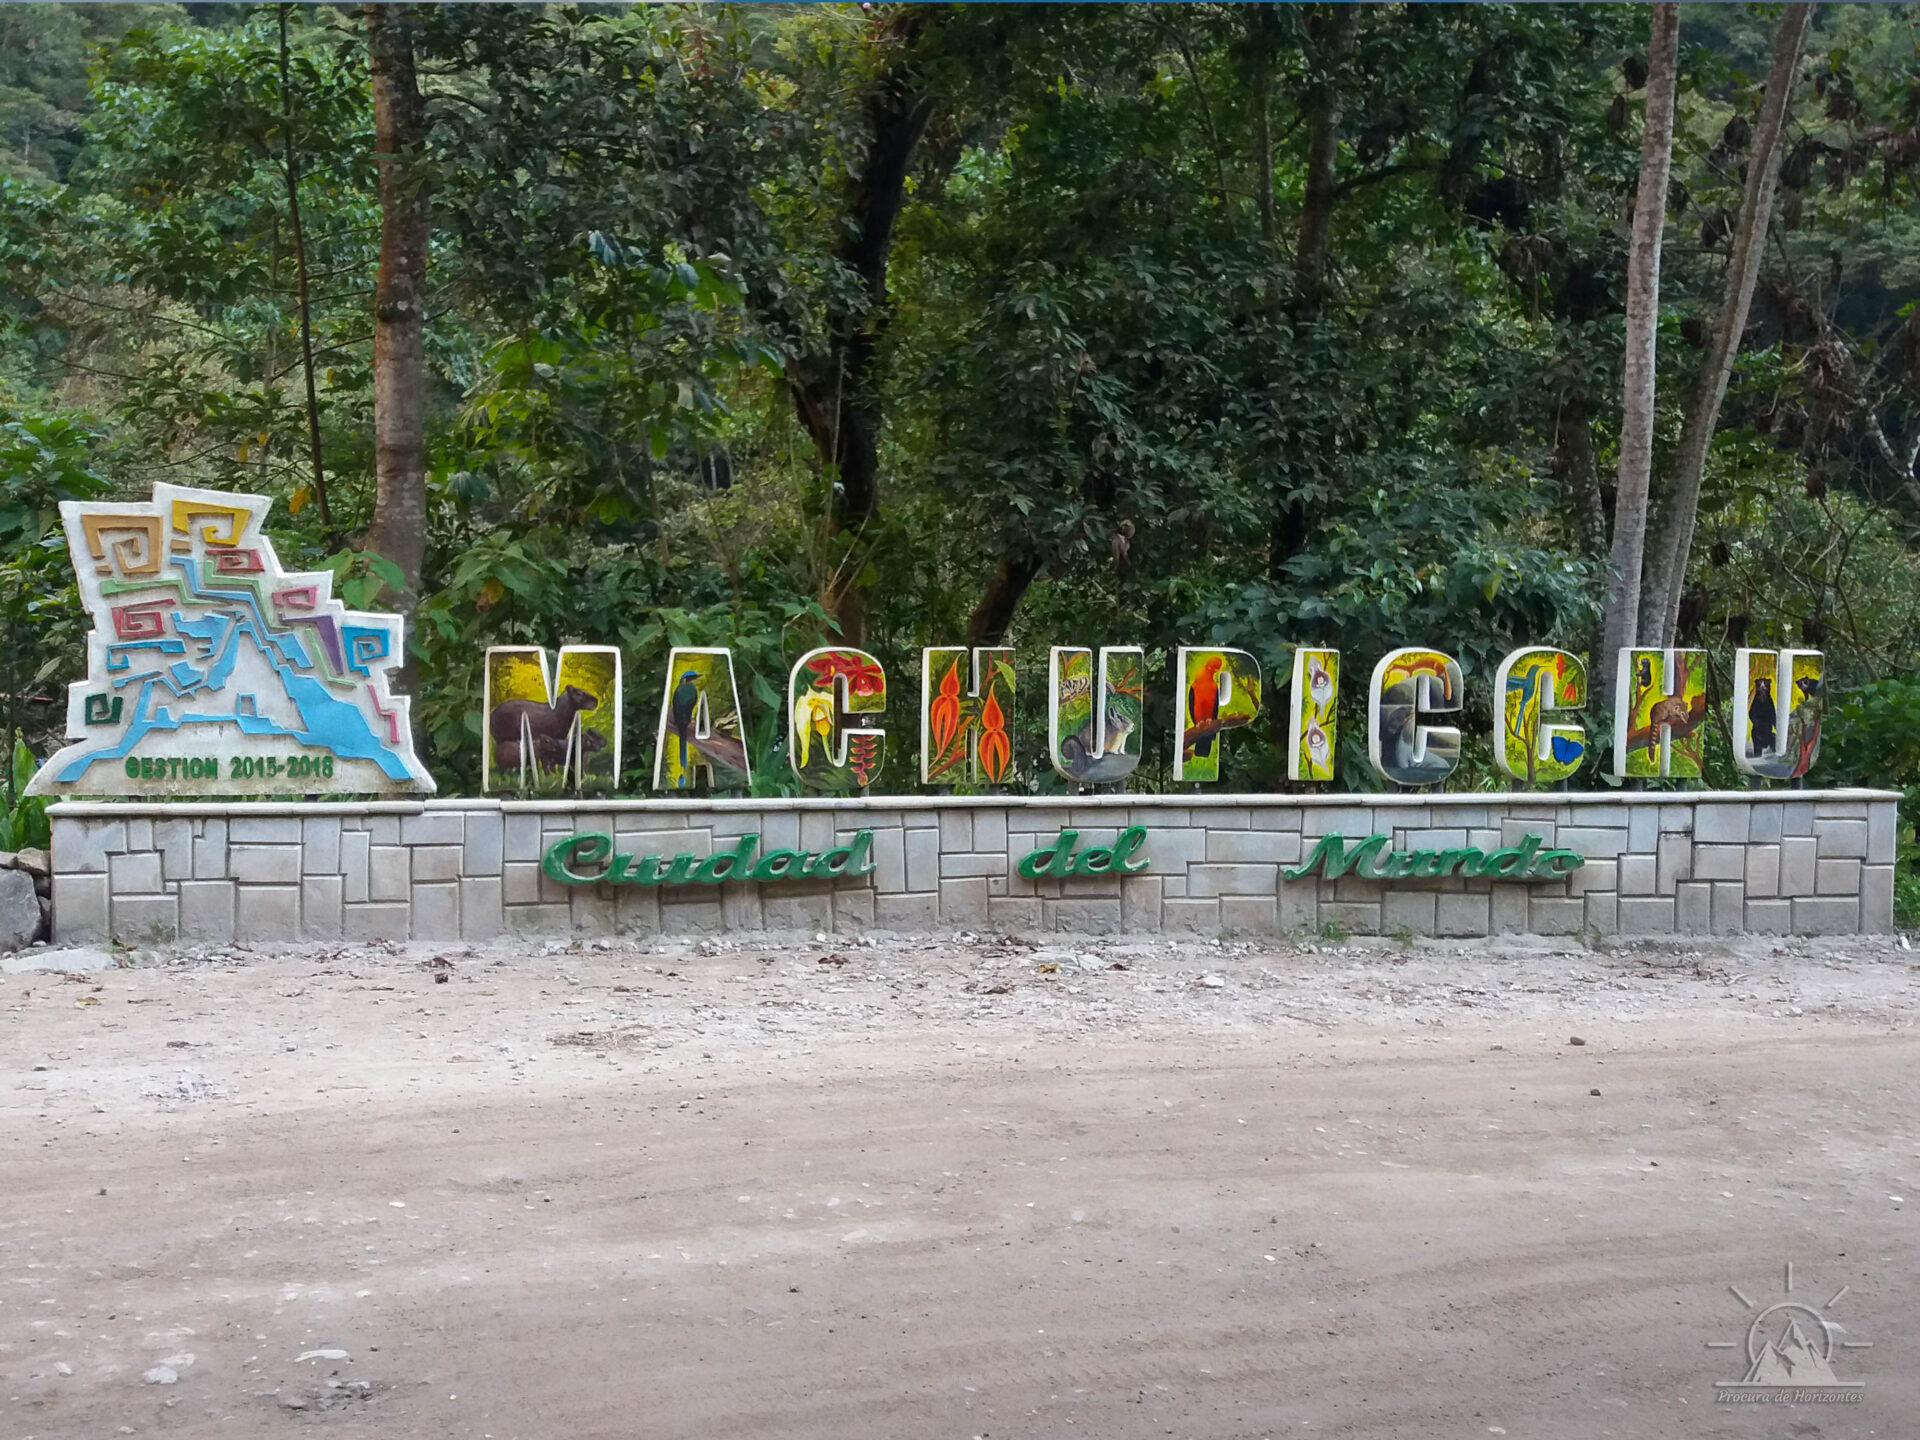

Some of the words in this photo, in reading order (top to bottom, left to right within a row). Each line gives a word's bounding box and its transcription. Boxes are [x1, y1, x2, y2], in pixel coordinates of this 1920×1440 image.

[125, 756, 219, 780] GESTION
[230, 756, 333, 780] 2015-2018
[1017, 825, 1151, 879] del
[1283, 831, 1585, 881] Mundo
